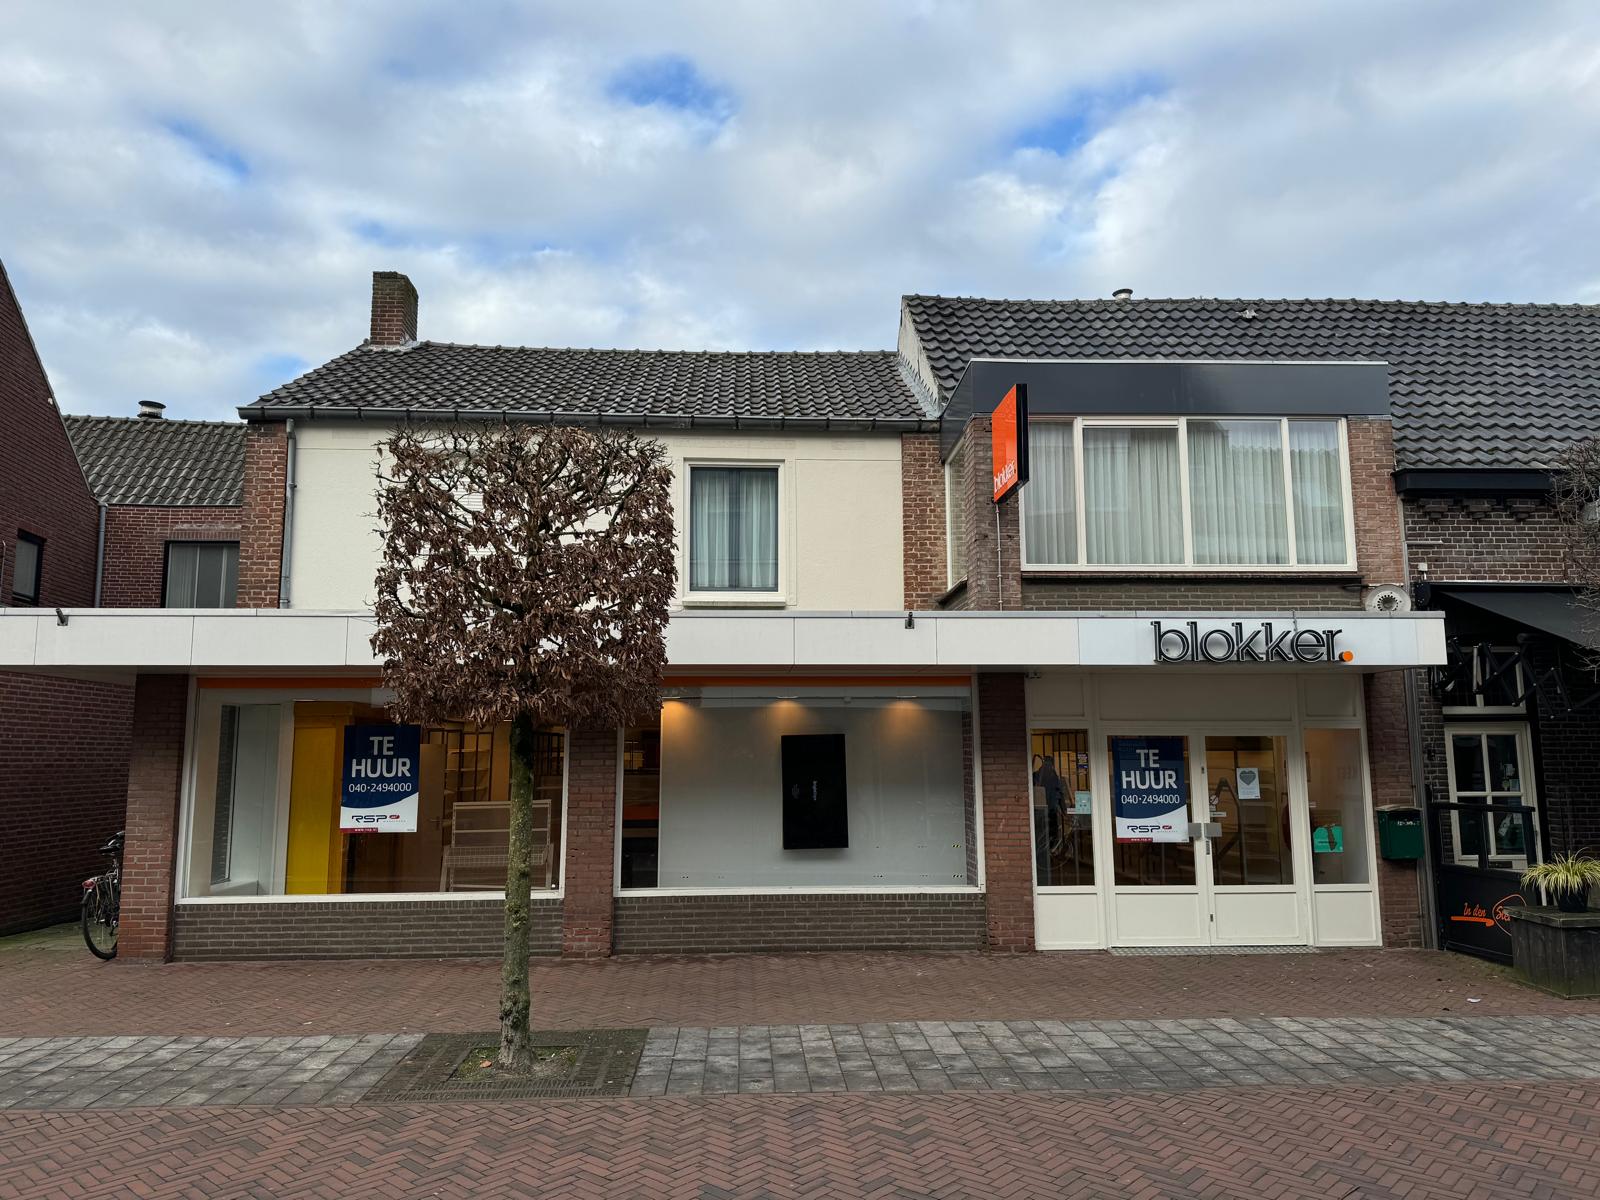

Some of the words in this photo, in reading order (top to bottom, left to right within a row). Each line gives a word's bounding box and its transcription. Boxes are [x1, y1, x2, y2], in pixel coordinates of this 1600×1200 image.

[369, 736, 395, 756] TE
[351, 758, 411, 778] HUUR
[1136, 749, 1160, 768] TE
[1121, 770, 1178, 790] HUUR
[351, 815, 387, 823] RSP
[1127, 825, 1160, 833] RSP
